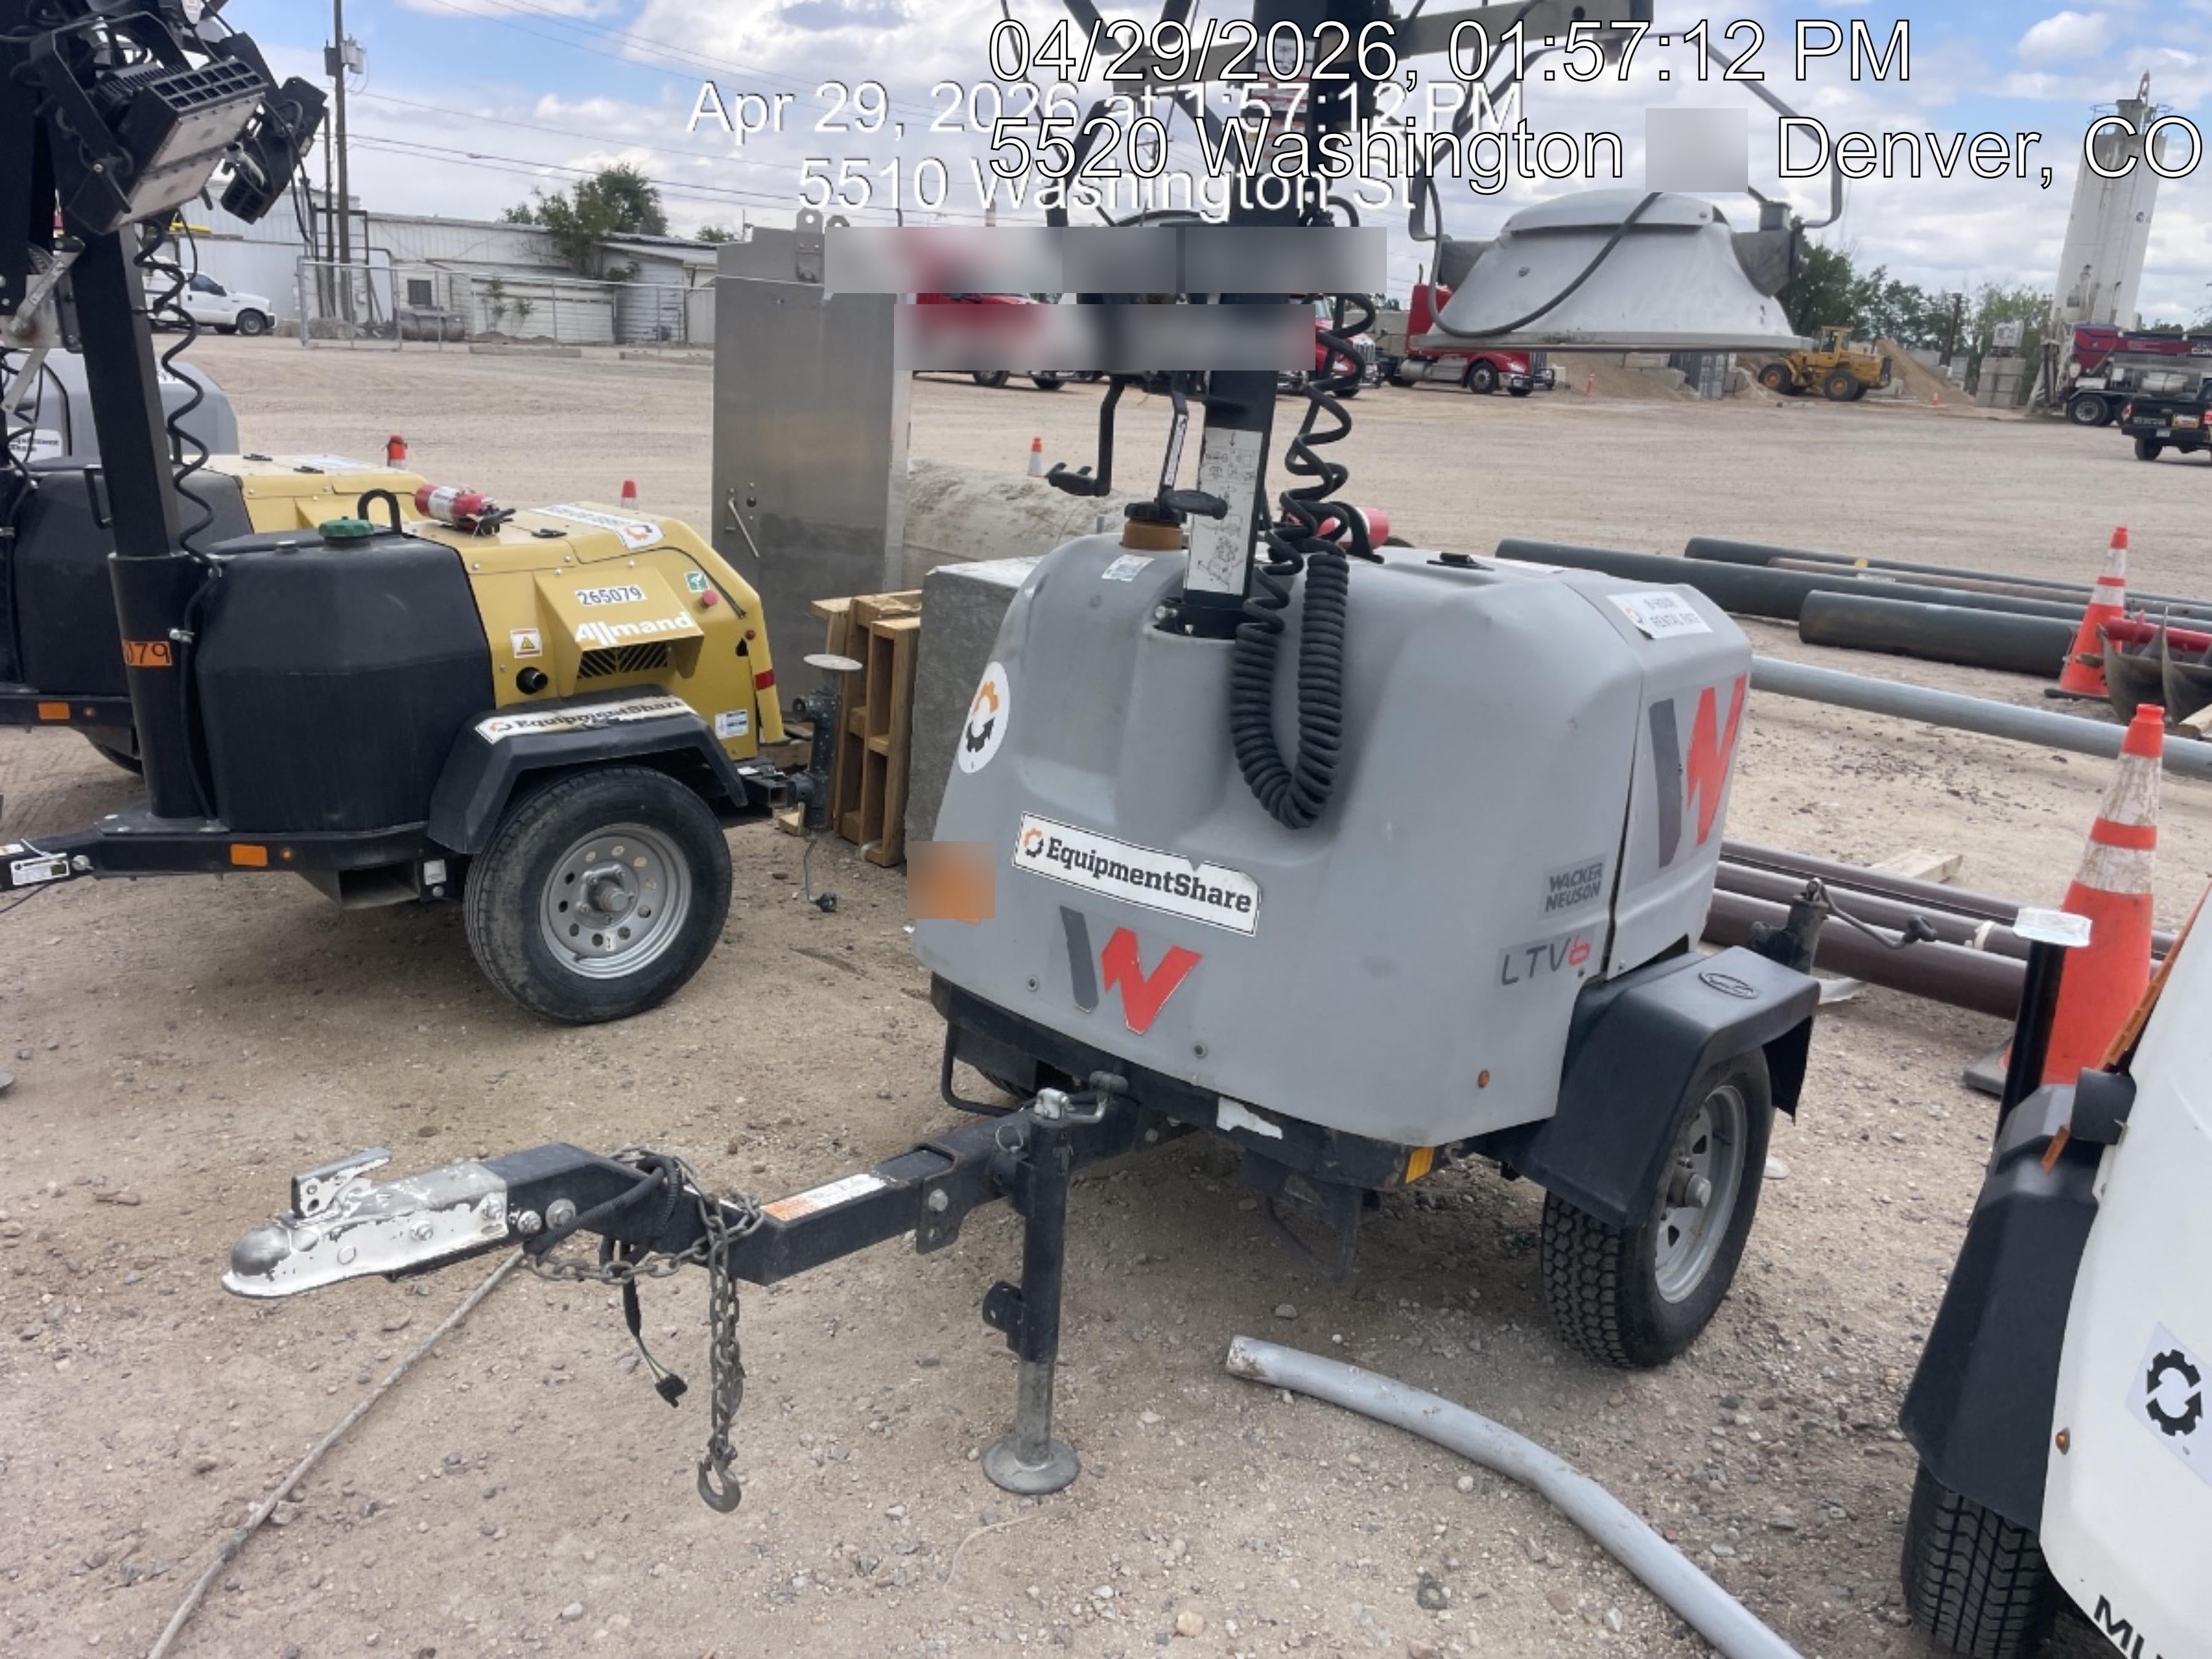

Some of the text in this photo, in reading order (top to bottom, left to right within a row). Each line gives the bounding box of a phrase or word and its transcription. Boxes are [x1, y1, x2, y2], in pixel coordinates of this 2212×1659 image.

[577, 586, 643, 605] 265079
[575, 611, 694, 645] Allmand
[1046, 836, 1252, 914] EquipmentShare
[1549, 862, 1602, 892] WACKER
[1545, 879, 1601, 912] NEUSON
[1502, 933, 1591, 986] LTV6
